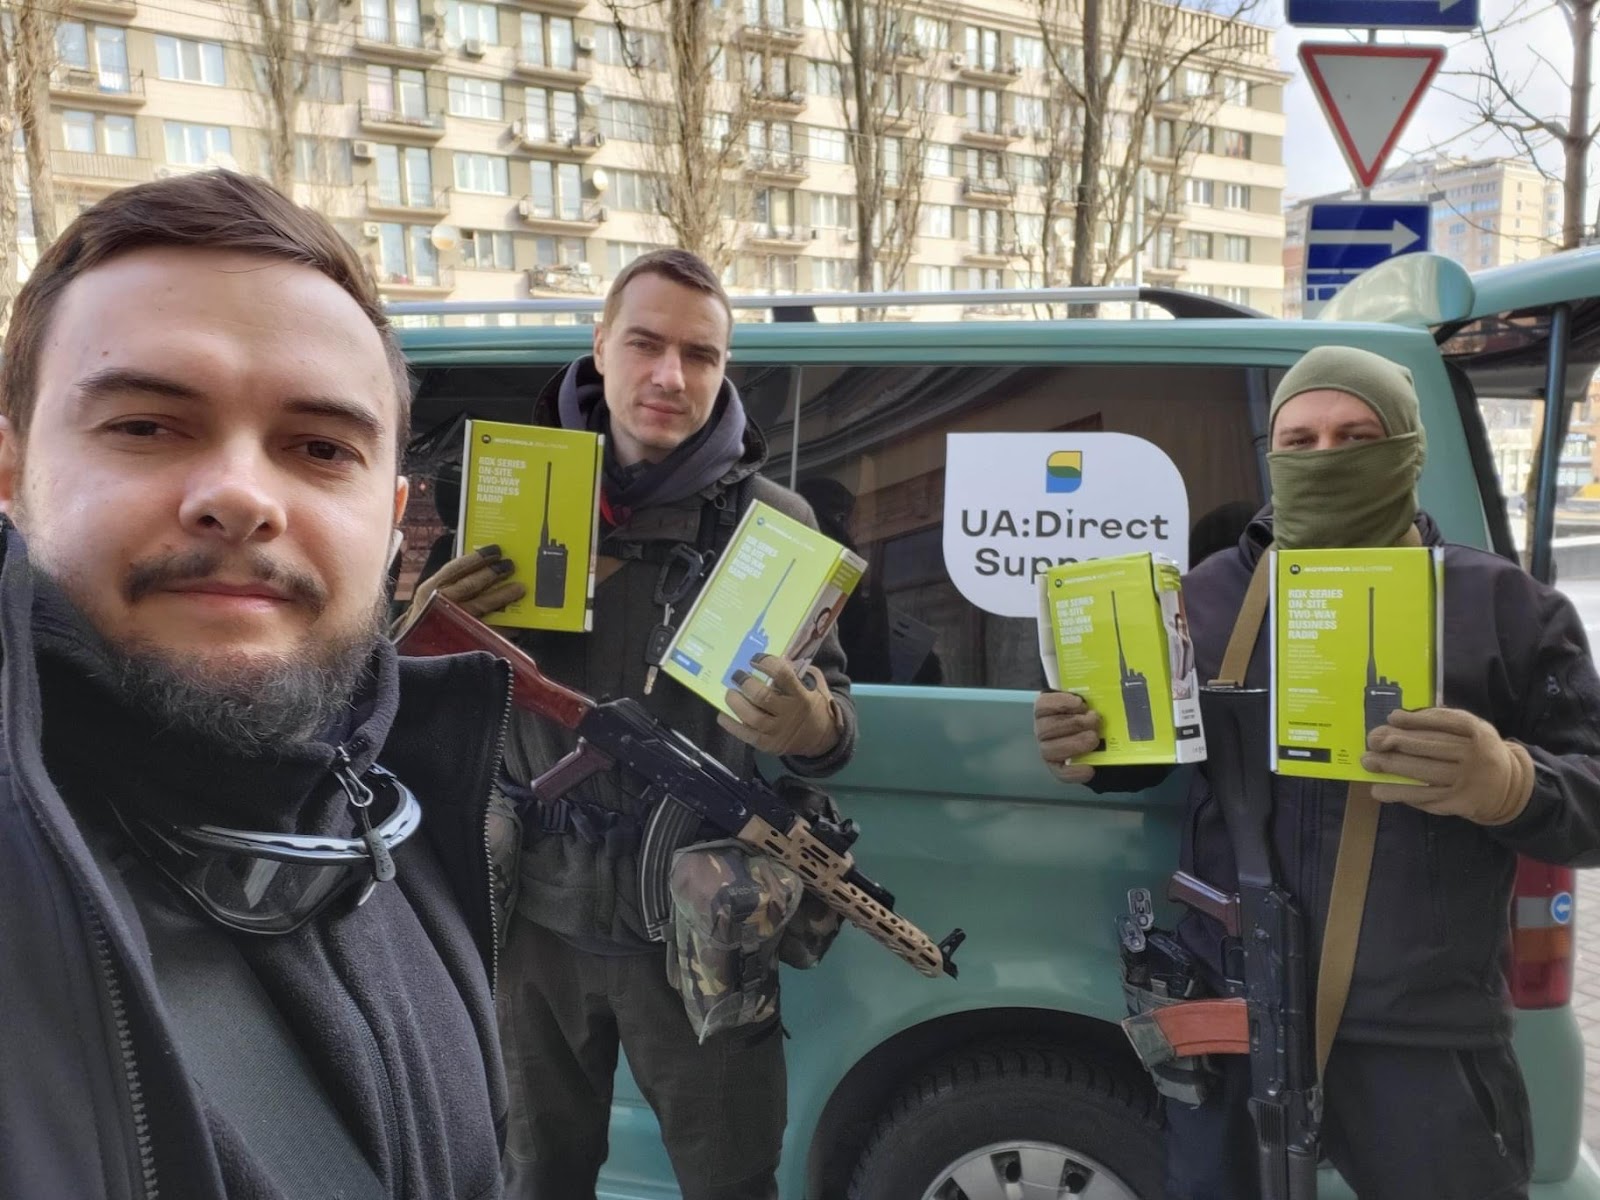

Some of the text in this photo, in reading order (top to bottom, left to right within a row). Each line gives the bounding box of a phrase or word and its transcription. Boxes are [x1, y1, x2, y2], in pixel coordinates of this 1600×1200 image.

[497, 458, 527, 469] SERIES
[478, 466, 513, 477] ON-SITE
[478, 475, 520, 487] TWO-WAY
[477, 484, 520, 496] BUSINESS
[476, 493, 503, 504] RADIO
[961, 508, 1169, 540] UA:Direct
[1309, 589, 1344, 599] SERIES
[1288, 599, 1328, 609] ON-SITE
[1288, 609, 1337, 619] TWO-WAY
[1288, 619, 1338, 630] BUSINESS
[1288, 630, 1319, 640] RADIO
